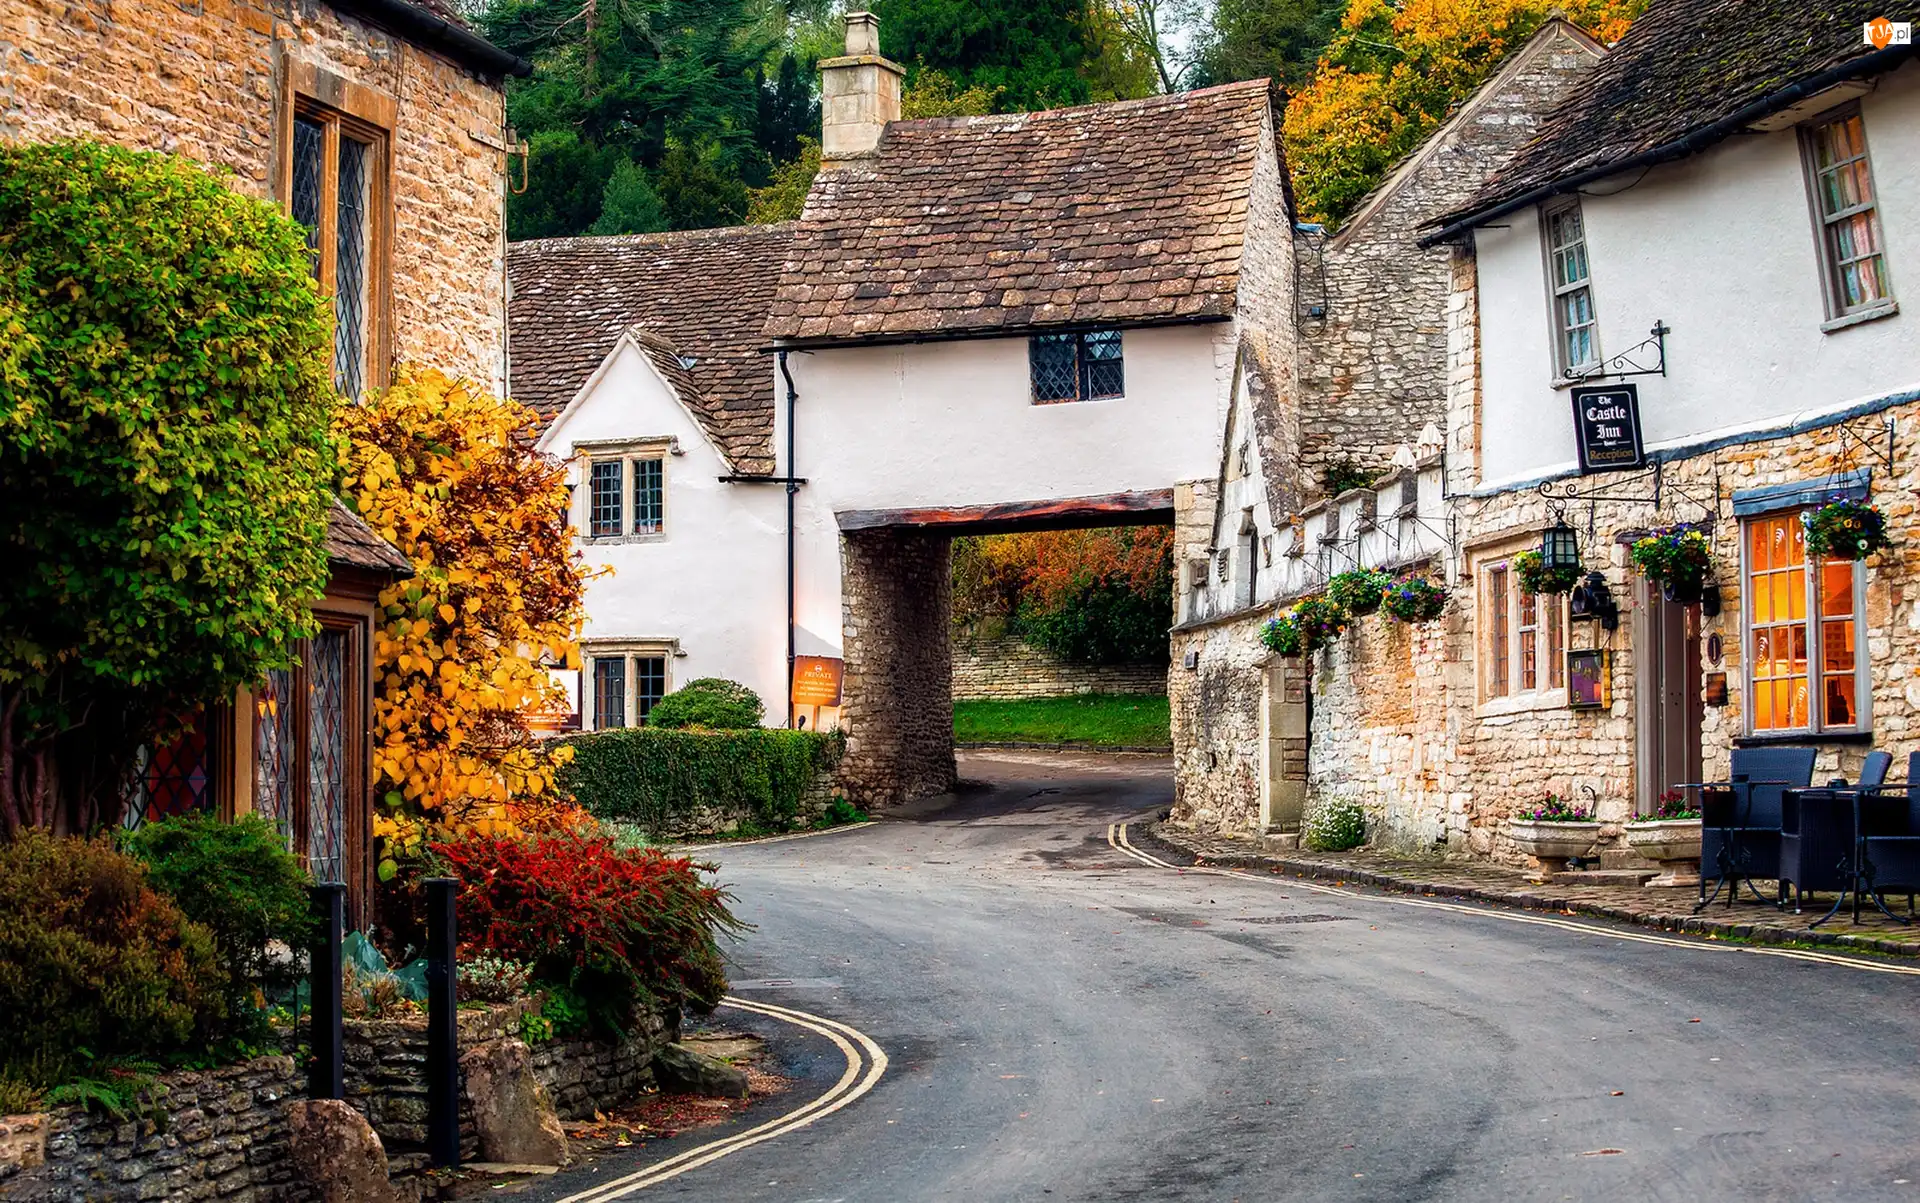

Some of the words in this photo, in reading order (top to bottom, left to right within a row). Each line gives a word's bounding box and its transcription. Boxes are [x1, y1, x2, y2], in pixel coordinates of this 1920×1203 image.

[1598, 396, 1612, 405] The
[1586, 405, 1626, 421] Castle
[1596, 424, 1622, 439] Inn
[1589, 449, 1634, 461] Reception
[804, 671, 832, 679] PRIVATE
